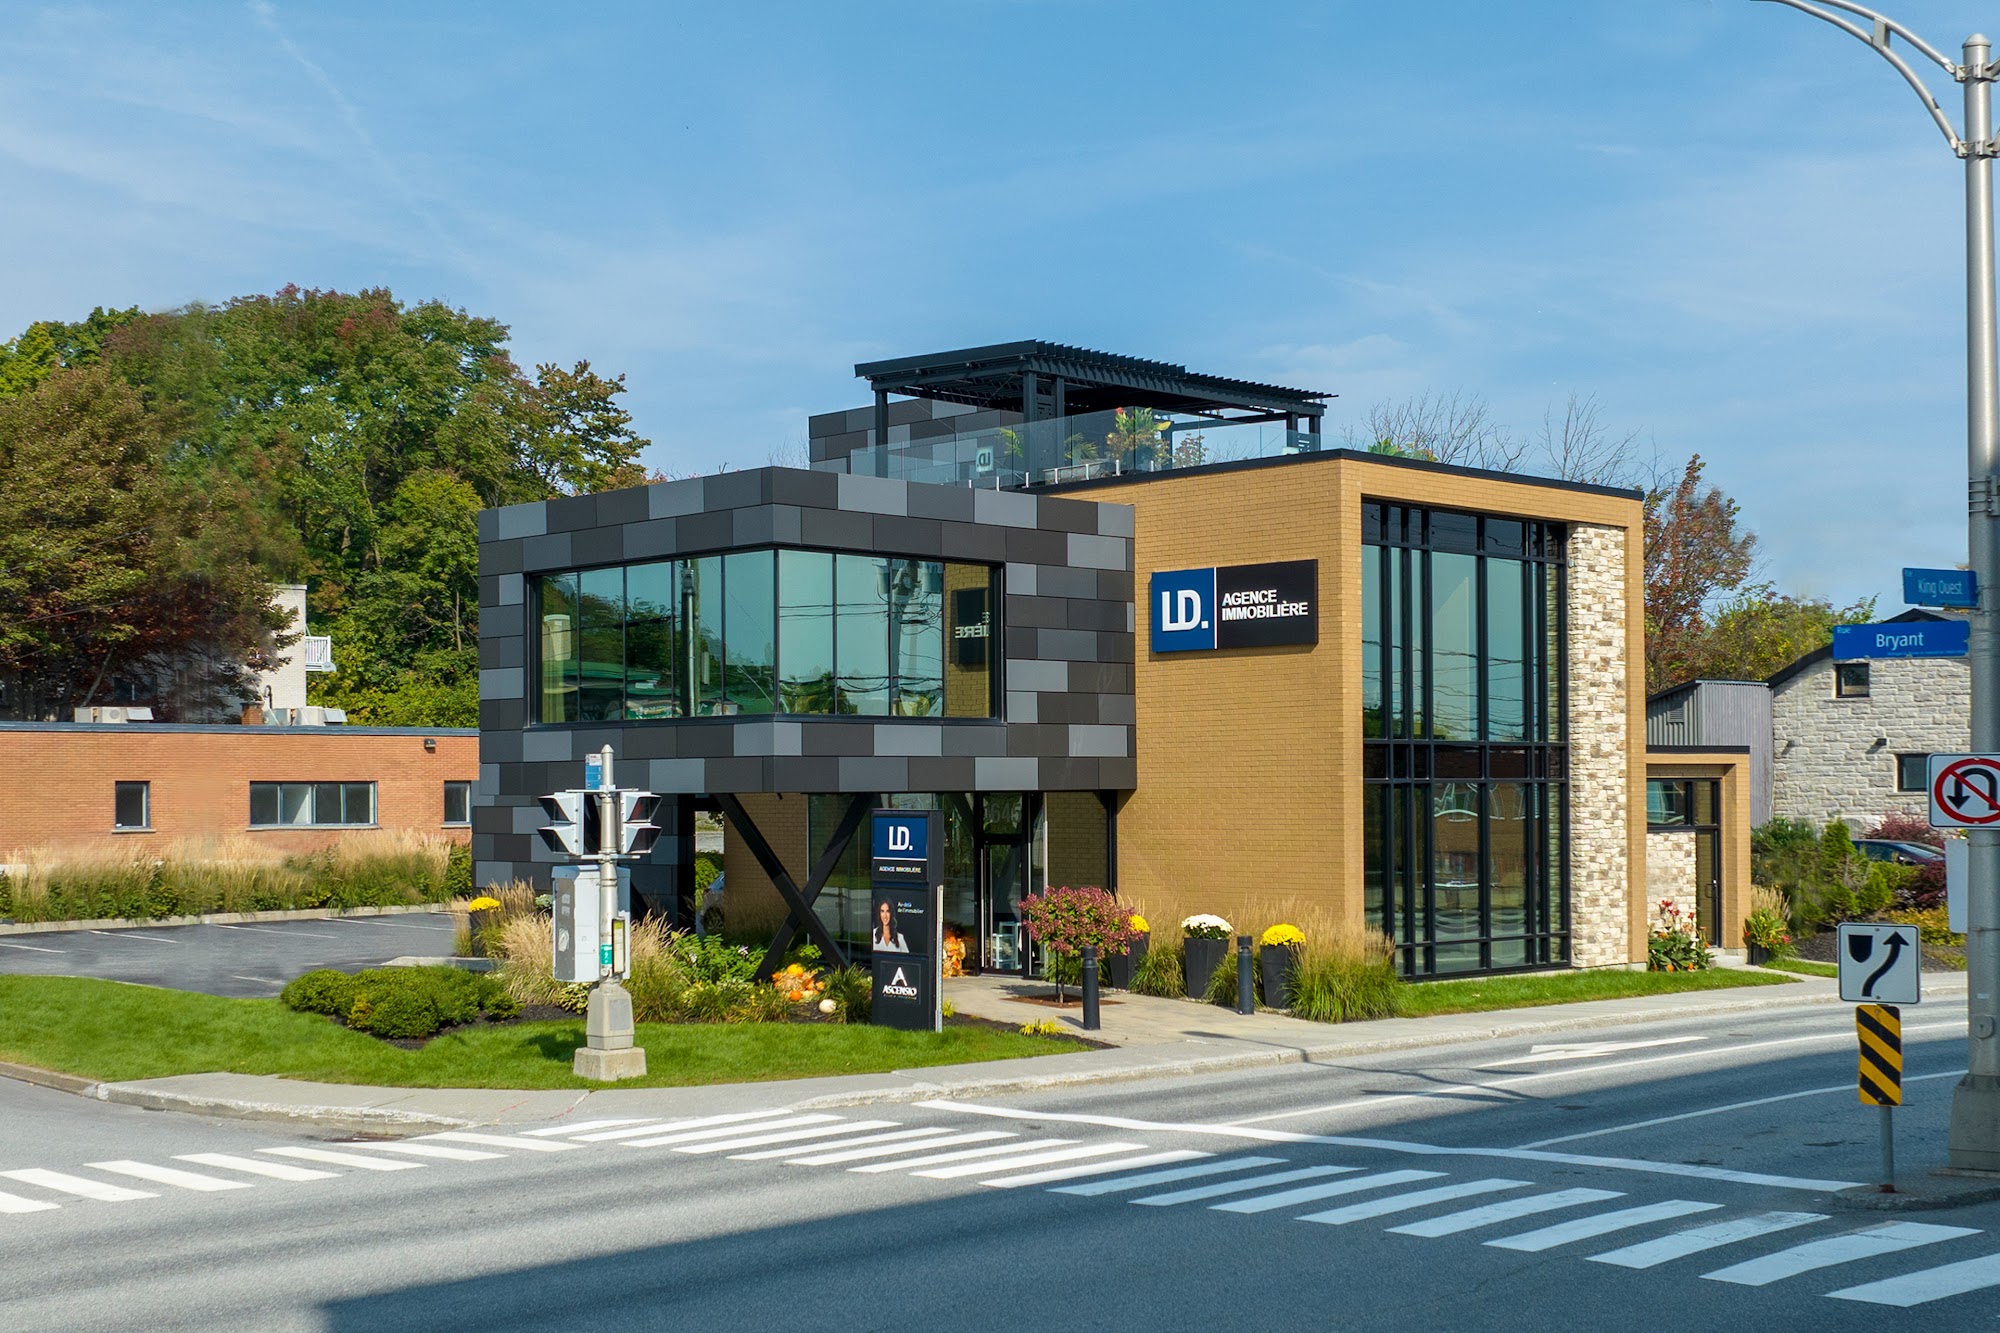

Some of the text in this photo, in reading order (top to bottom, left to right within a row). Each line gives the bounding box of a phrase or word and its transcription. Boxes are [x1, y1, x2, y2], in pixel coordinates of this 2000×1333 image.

[1221, 589, 1278, 607] AGENCE
[1917, 578, 1963, 598] King Ouest
[1161, 589, 1209, 632] LD.
[1221, 601, 1309, 622] IMMOBILIÈRE
[1836, 626, 1851, 634] Rue
[1875, 631, 1925, 651] Bryant
[888, 825, 914, 851] LD.
